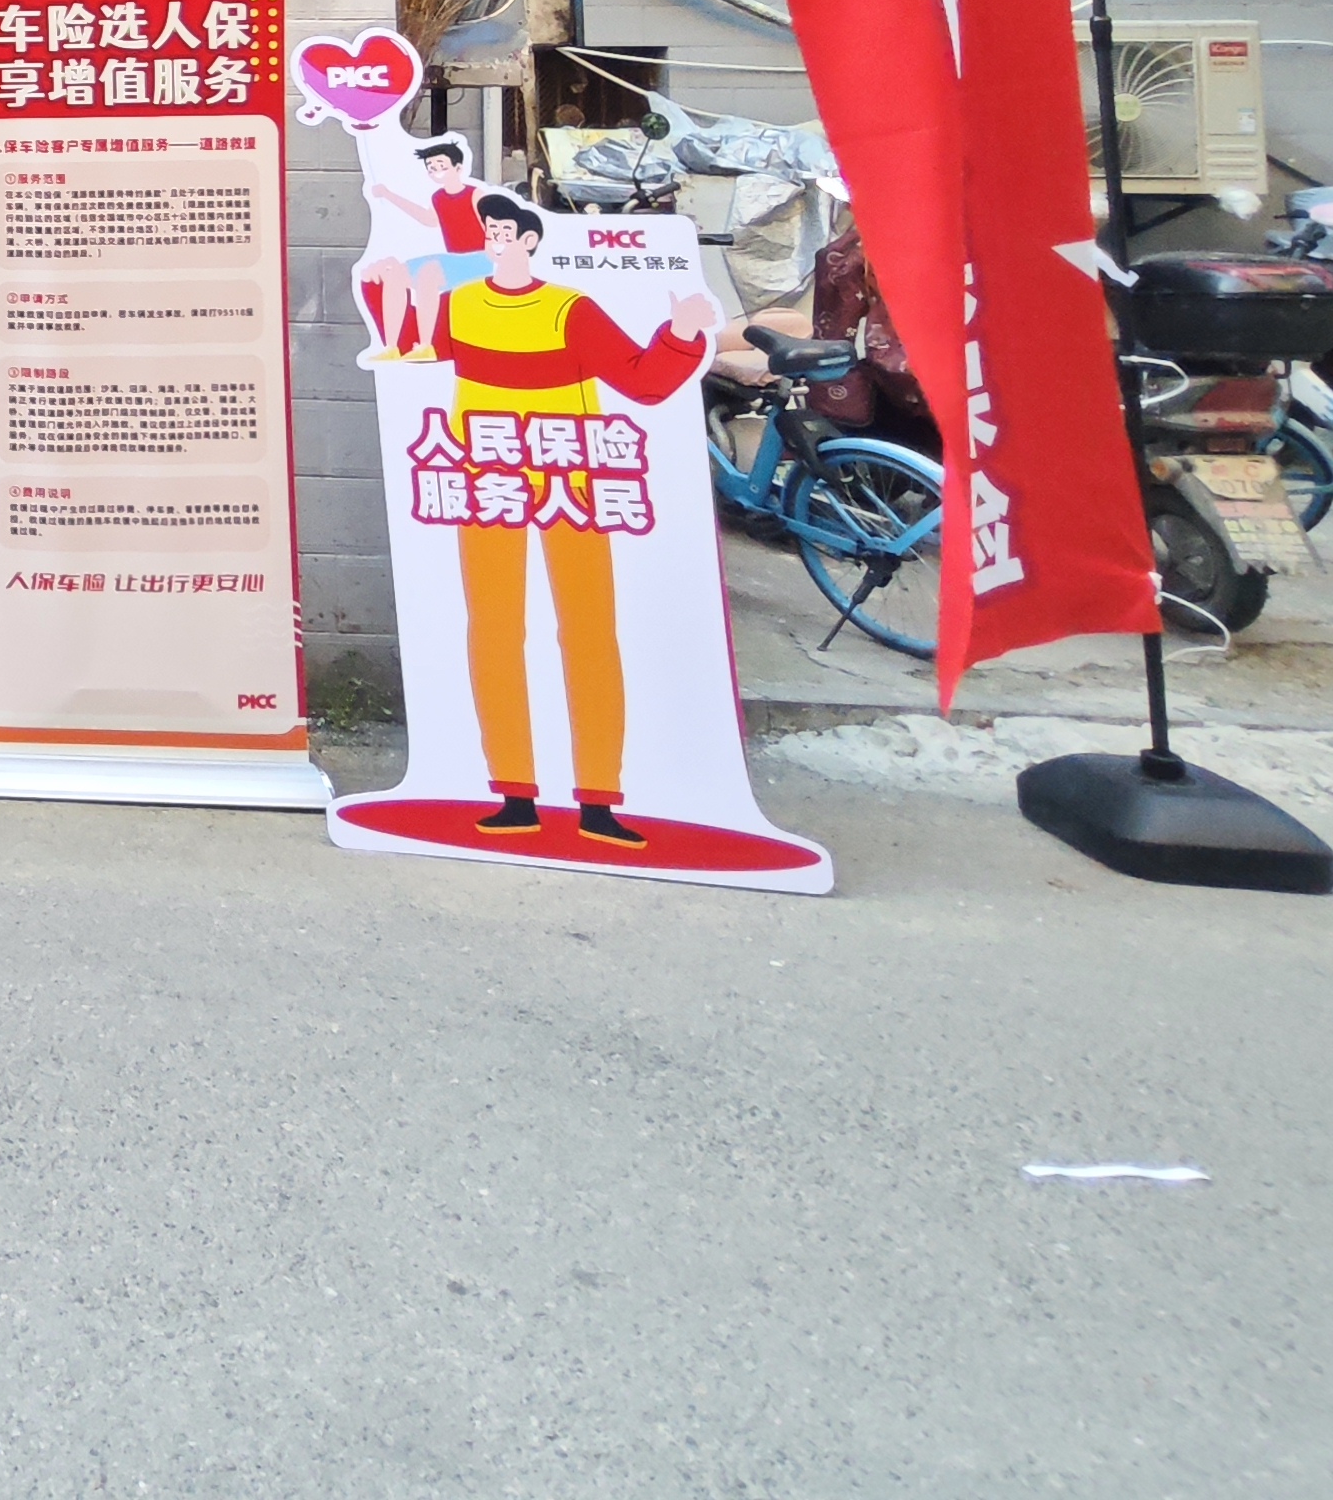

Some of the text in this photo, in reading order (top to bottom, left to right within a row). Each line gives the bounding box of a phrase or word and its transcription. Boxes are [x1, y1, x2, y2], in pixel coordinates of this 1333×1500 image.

[326, 65, 390, 88] PICC
[588, 229, 647, 248] PICC
[551, 255, 689, 271] 中国人民保险
[414, 412, 647, 470] 人民保险
[417, 472, 652, 531] 服务人民
[5, 571, 265, 594] 人保车险 让出行更安心
[238, 694, 277, 709] PICC
